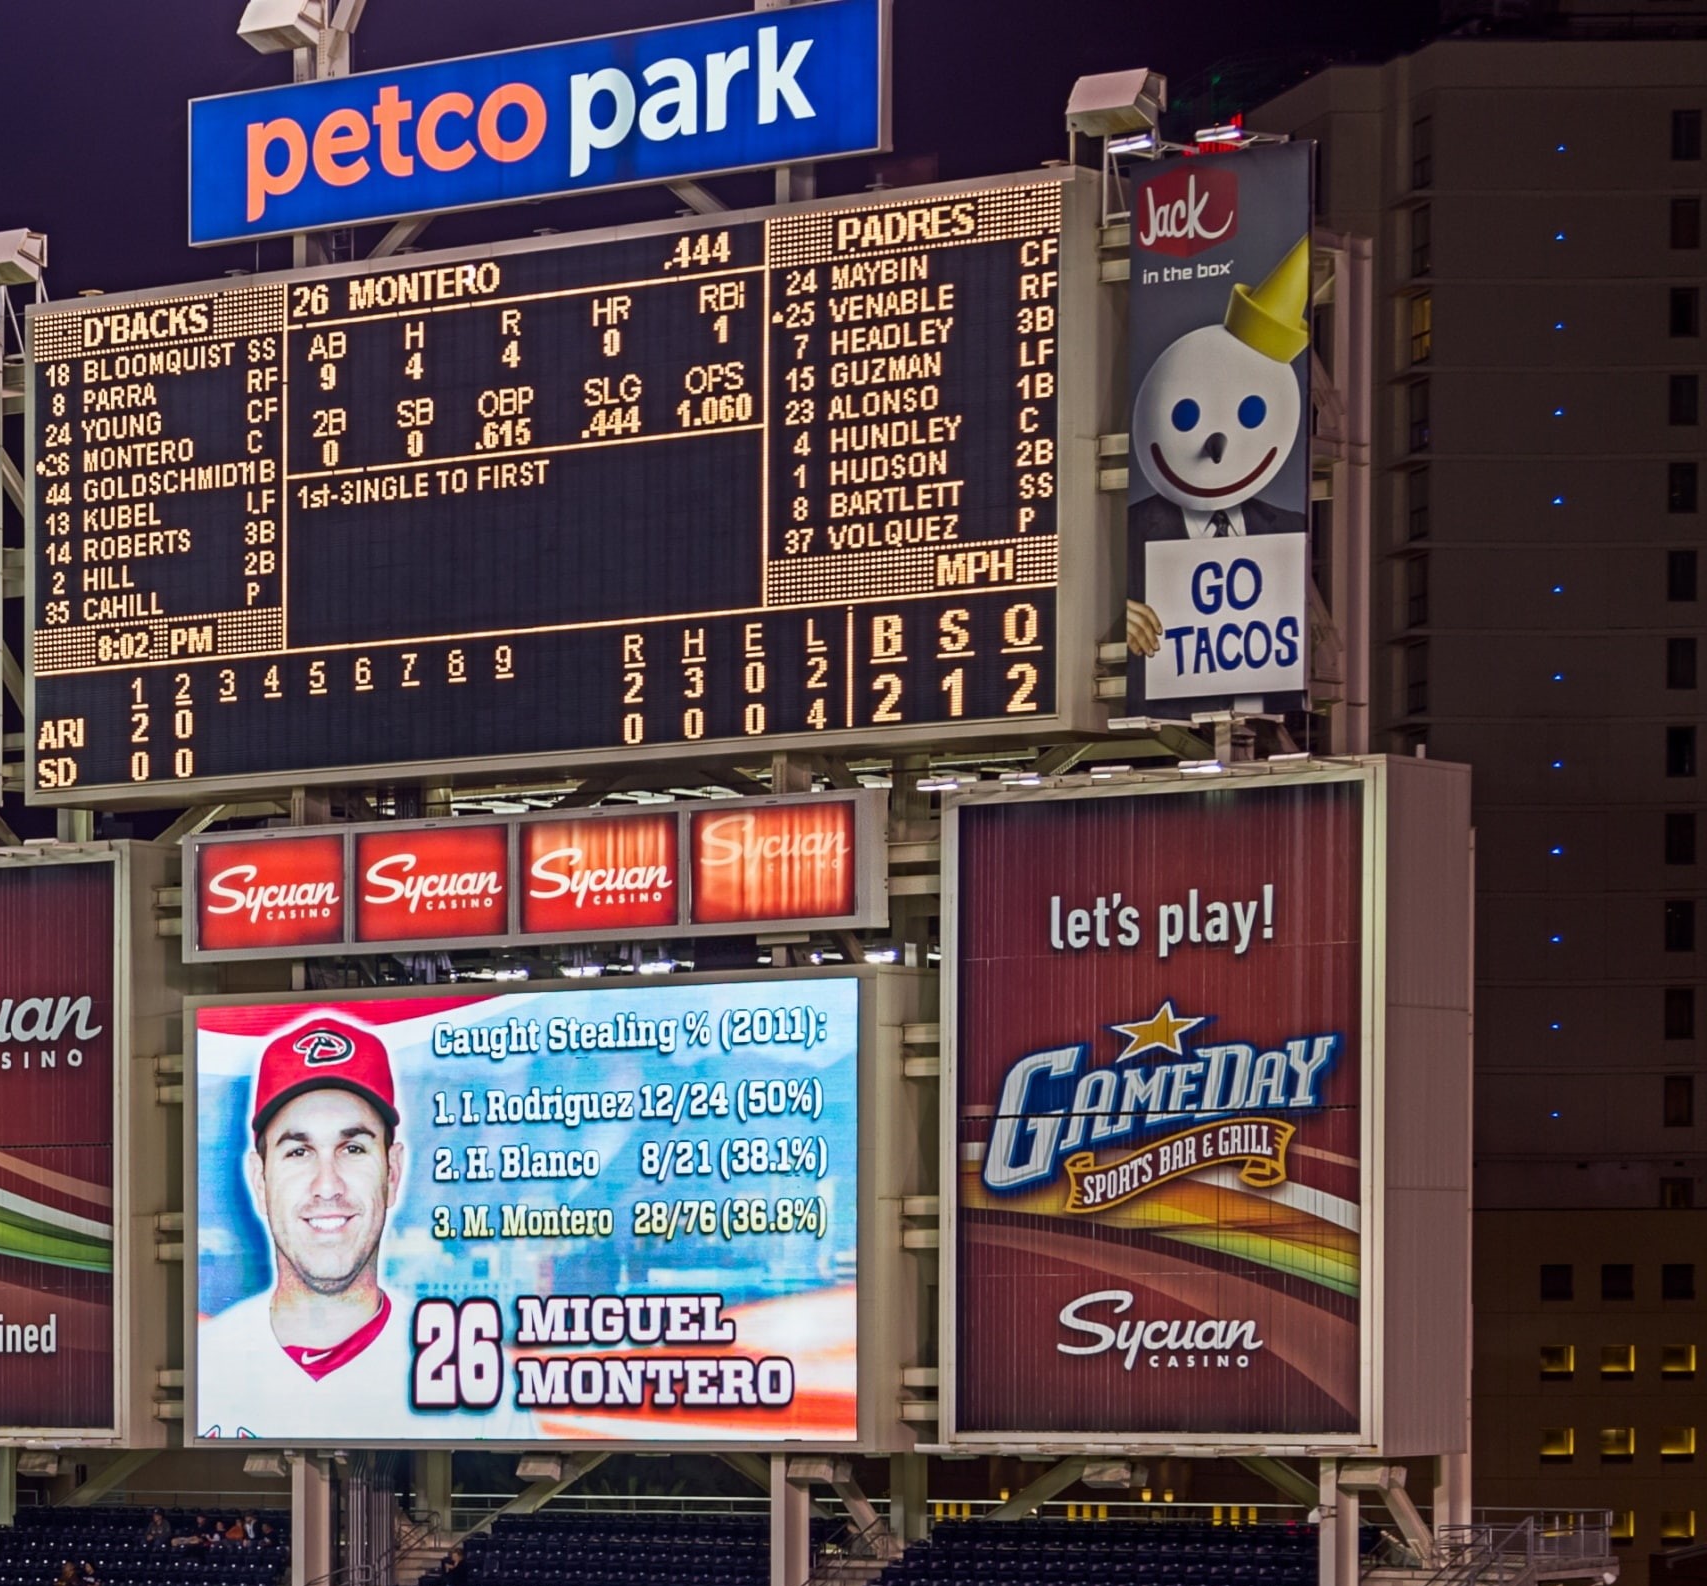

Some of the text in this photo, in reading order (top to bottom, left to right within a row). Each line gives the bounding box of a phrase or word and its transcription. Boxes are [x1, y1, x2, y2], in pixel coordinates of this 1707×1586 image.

[247, 26, 816, 222] petco park
[838, 203, 974, 251] PADRES
[1140, 174, 1233, 247] Jack
[293, 262, 500, 318] 26 MONTERO
[832, 255, 928, 290] MAYBIN
[1142, 264, 1230, 284] in the box
[828, 284, 954, 322] VENABLE
[84, 304, 208, 347] D'BACKS
[831, 317, 953, 355] HEADLEY
[84, 343, 235, 383] BLOOMQUIST
[831, 352, 941, 388] GUZMAN
[84, 382, 157, 413] PARRA
[828, 385, 938, 421] ALONSO
[81, 411, 161, 443] YOUNG
[830, 415, 962, 453] HUNDLEY
[84, 438, 193, 473] MONTERO
[830, 449, 947, 486] HUDSON
[437, 469, 467, 494] TO
[477, 460, 549, 491] FIRST
[84, 502, 161, 532] KUBEL
[830, 480, 964, 518] BARTLETT
[84, 529, 191, 562] ROBERTS
[828, 514, 958, 549] VOLQUEZ
[84, 565, 134, 591] HILL
[937, 549, 1014, 586] MPH
[1191, 558, 1262, 615] GO
[84, 592, 164, 621] CAHILL
[98, 626, 212, 661] 8:02 PM
[1165, 616, 1299, 677] TACOS
[700, 815, 849, 874] Sycuan
[208, 864, 339, 922] Sycuan
[365, 854, 502, 913] Sycuan
[530, 848, 672, 908] Sycuan
[266, 907, 331, 921] CASINO
[426, 897, 493, 912] CASINO
[593, 890, 663, 905] CASINO
[1050, 884, 1274, 958] let's play!
[433, 1006, 827, 1059] Caught Stealing % (2011):
[434, 1078, 824, 1130] 1. I. Rodriguez 12/24 (50%)
[434, 1137, 827, 1183] 2. H. Blanco 8/21 (38.1%)
[1082, 1124, 1273, 1206] SPORTS BAR & GRILL
[433, 1197, 827, 1243] 3. M. Montero 28/76 (36.8%)
[1057, 1289, 1263, 1370] Sycuan
[413, 1296, 736, 1408] 26 MIGUEL
[1149, 1355, 1249, 1368] CASINO
[516, 1358, 794, 1407] MONTERO
